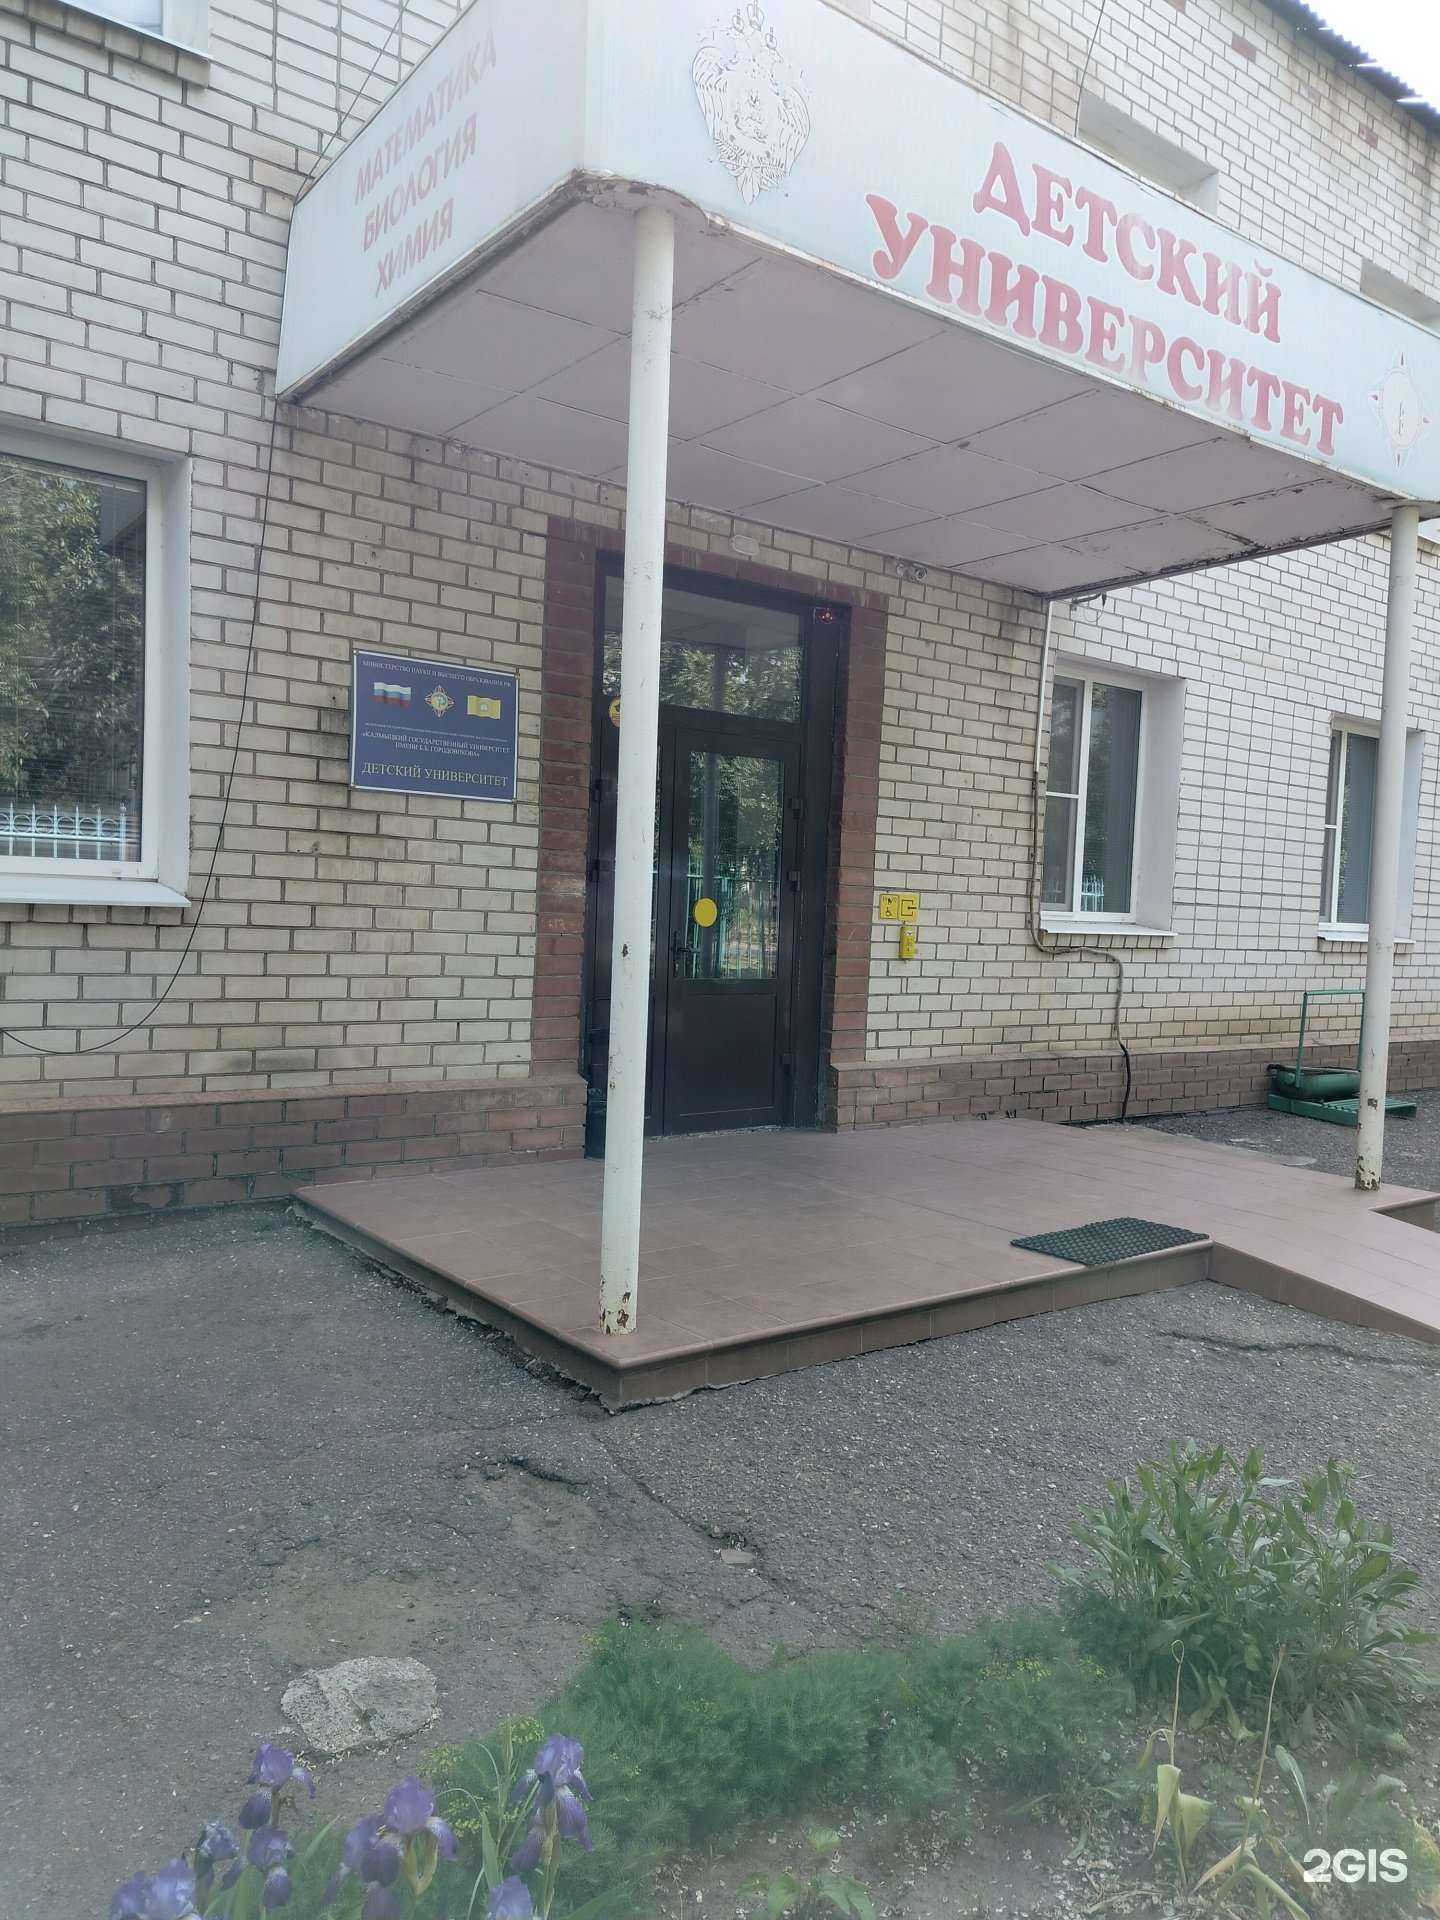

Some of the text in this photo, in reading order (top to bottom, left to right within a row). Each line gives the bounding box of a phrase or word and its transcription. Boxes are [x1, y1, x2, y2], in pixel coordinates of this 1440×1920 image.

[354, 30, 497, 205] МАТЕМАТИКА
[363, 112, 477, 254] БИОЛОГИЯ
[375, 198, 454, 298] ХИМИЯ
[973, 140, 1282, 344] ДЕТСКИЙ
[865, 192, 1344, 456] УНИВЕРСИТЕТ
[361, 762, 508, 788] ДЕТСКИЙ УНИВЕРСИТЕТ
